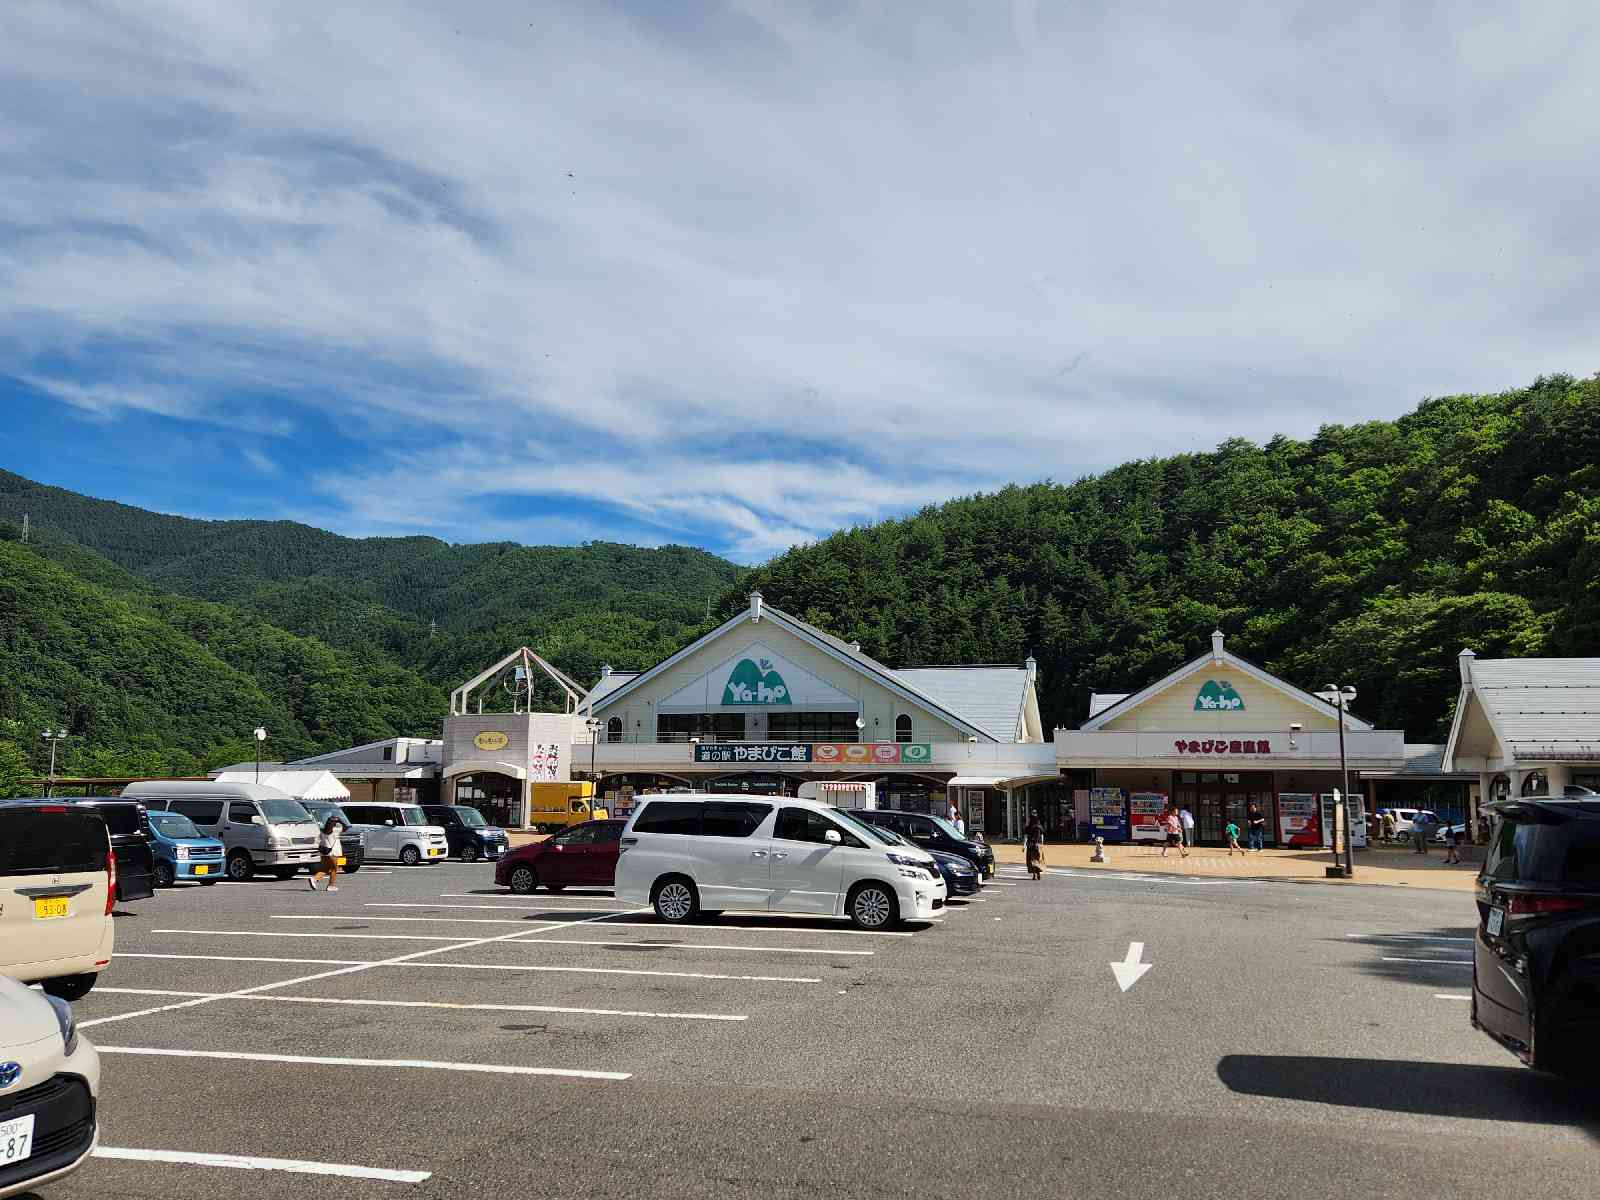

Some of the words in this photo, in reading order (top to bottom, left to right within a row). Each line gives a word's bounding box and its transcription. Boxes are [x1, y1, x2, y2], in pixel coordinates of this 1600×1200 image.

[733, 745, 807, 761] やまびこ館
